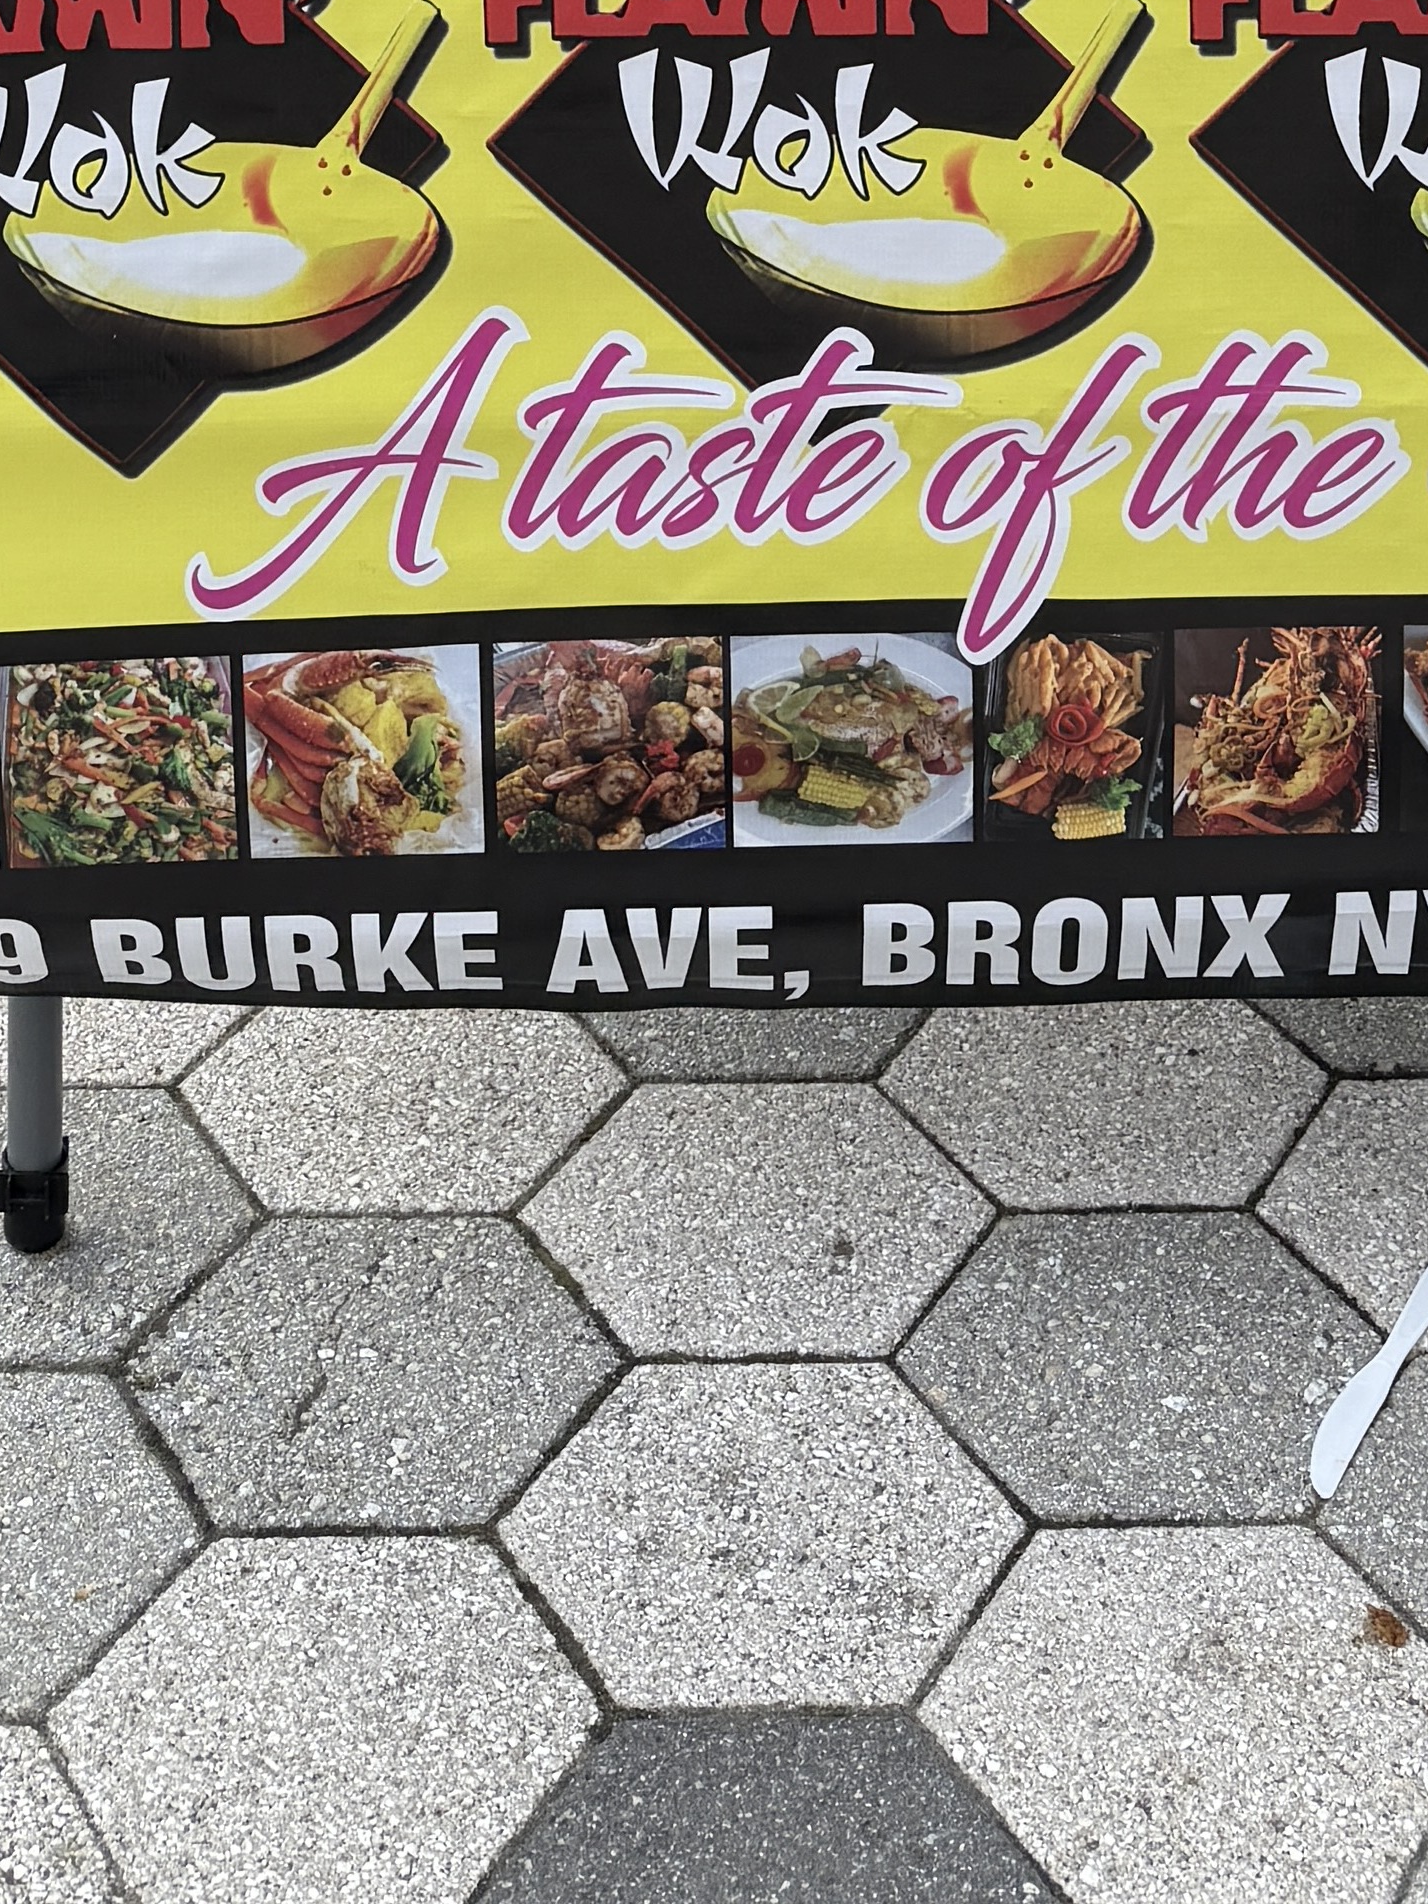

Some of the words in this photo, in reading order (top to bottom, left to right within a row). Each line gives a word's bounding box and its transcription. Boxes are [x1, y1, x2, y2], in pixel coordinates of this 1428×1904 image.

[617, 45, 930, 201] Wok
[186, 307, 529, 620] A
[504, 330, 960, 546] taste
[922, 336, 1160, 660] of
[1123, 331, 1408, 542] the
[89, 909, 505, 995] BURKE
[544, 903, 814, 1003] AVE,
[861, 892, 1292, 987] BRONX
